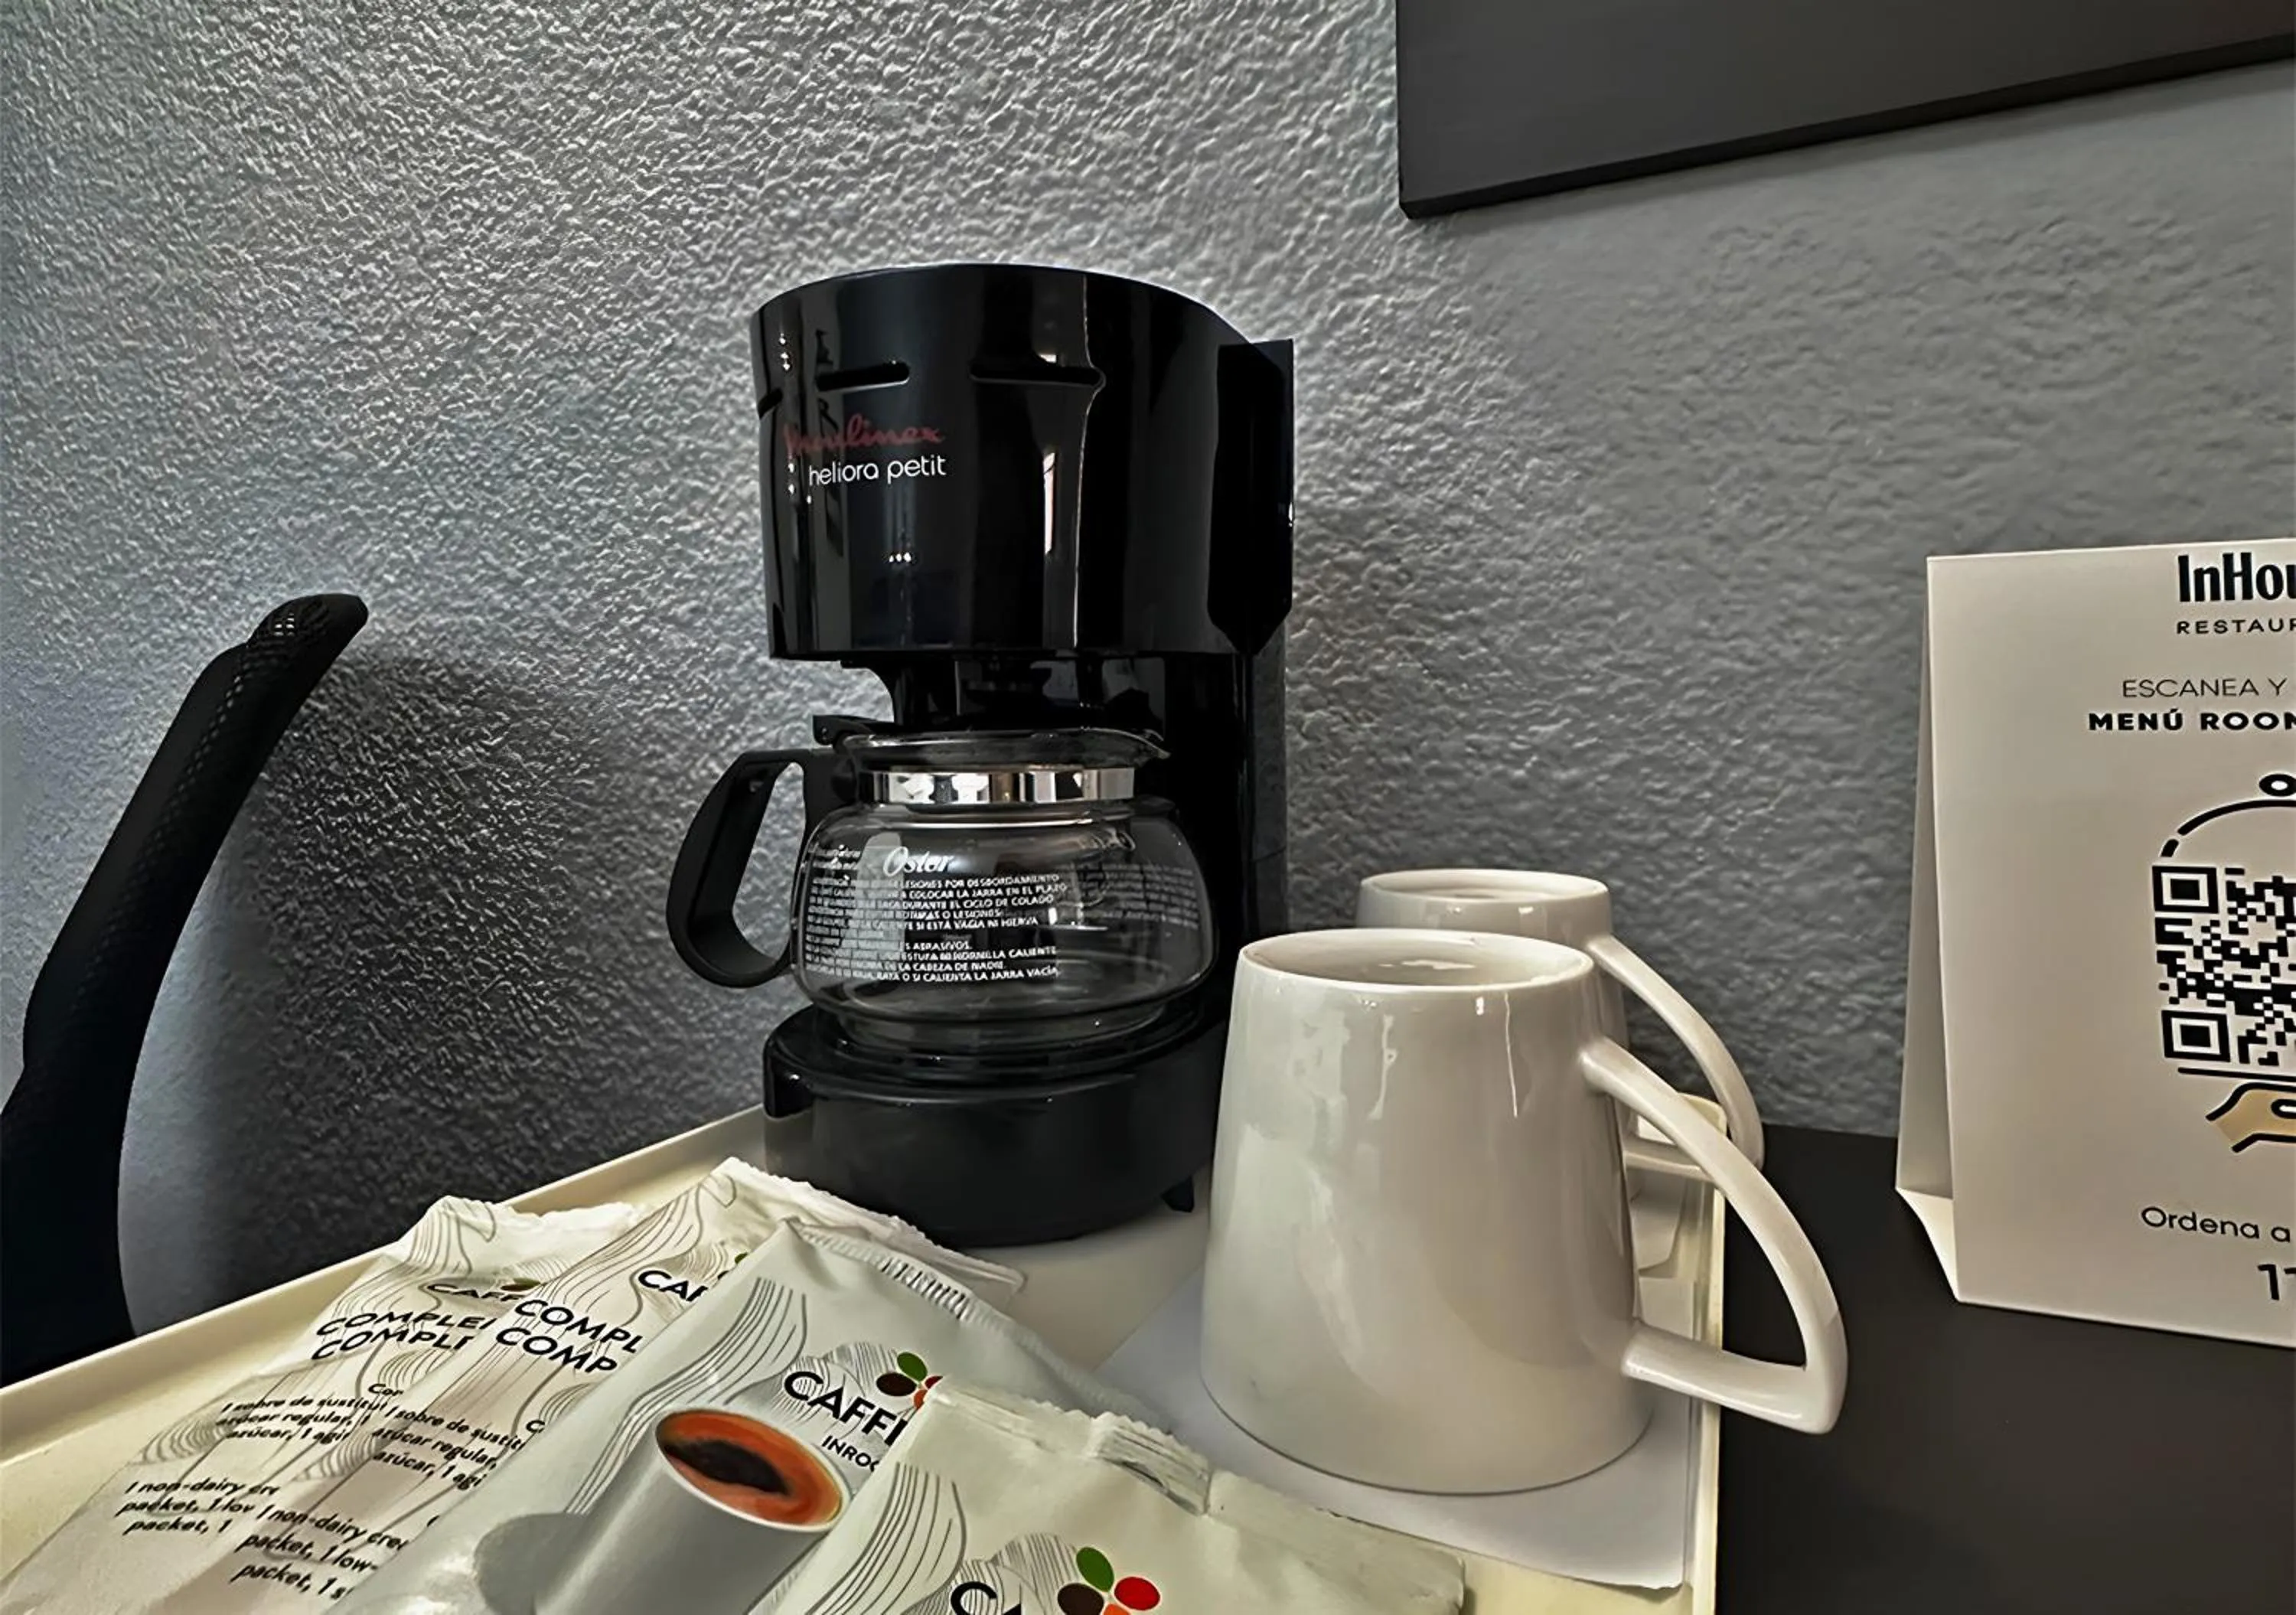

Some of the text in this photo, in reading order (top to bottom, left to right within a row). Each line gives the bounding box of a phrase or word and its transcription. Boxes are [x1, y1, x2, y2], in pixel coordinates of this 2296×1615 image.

[809, 454, 947, 486] heliora petit
[2122, 677, 2288, 698] ESCANEA Y
[2089, 708, 2183, 731] MENÚ
[956, 889, 970, 899] LA
[972, 888, 1004, 898] JARRA
[995, 898, 1008, 907] DE
[1011, 893, 1054, 906] COLADO
[942, 910, 951, 919] O
[902, 972, 911, 982] O
[974, 971, 988, 980] LA
[990, 970, 1024, 980] JARRA
[954, 962, 968, 971] DE
[2141, 1206, 2291, 1243] Ordena a
[496, 1326, 618, 1373] COMP
[289, 1395, 314, 1407] de
[395, 1410, 445, 1426] sobre
[446, 1418, 470, 1434] de
[440, 1465, 457, 1479] 1
[138, 1477, 246, 1496] non-dairy
[114, 1496, 199, 1517] packet,
[122, 1516, 233, 1536] packet, 1
[268, 1509, 368, 1545] non-dairy
[233, 1532, 315, 1560] packet,
[229, 1563, 312, 1594] packet,
[318, 1577, 337, 1595] 1
